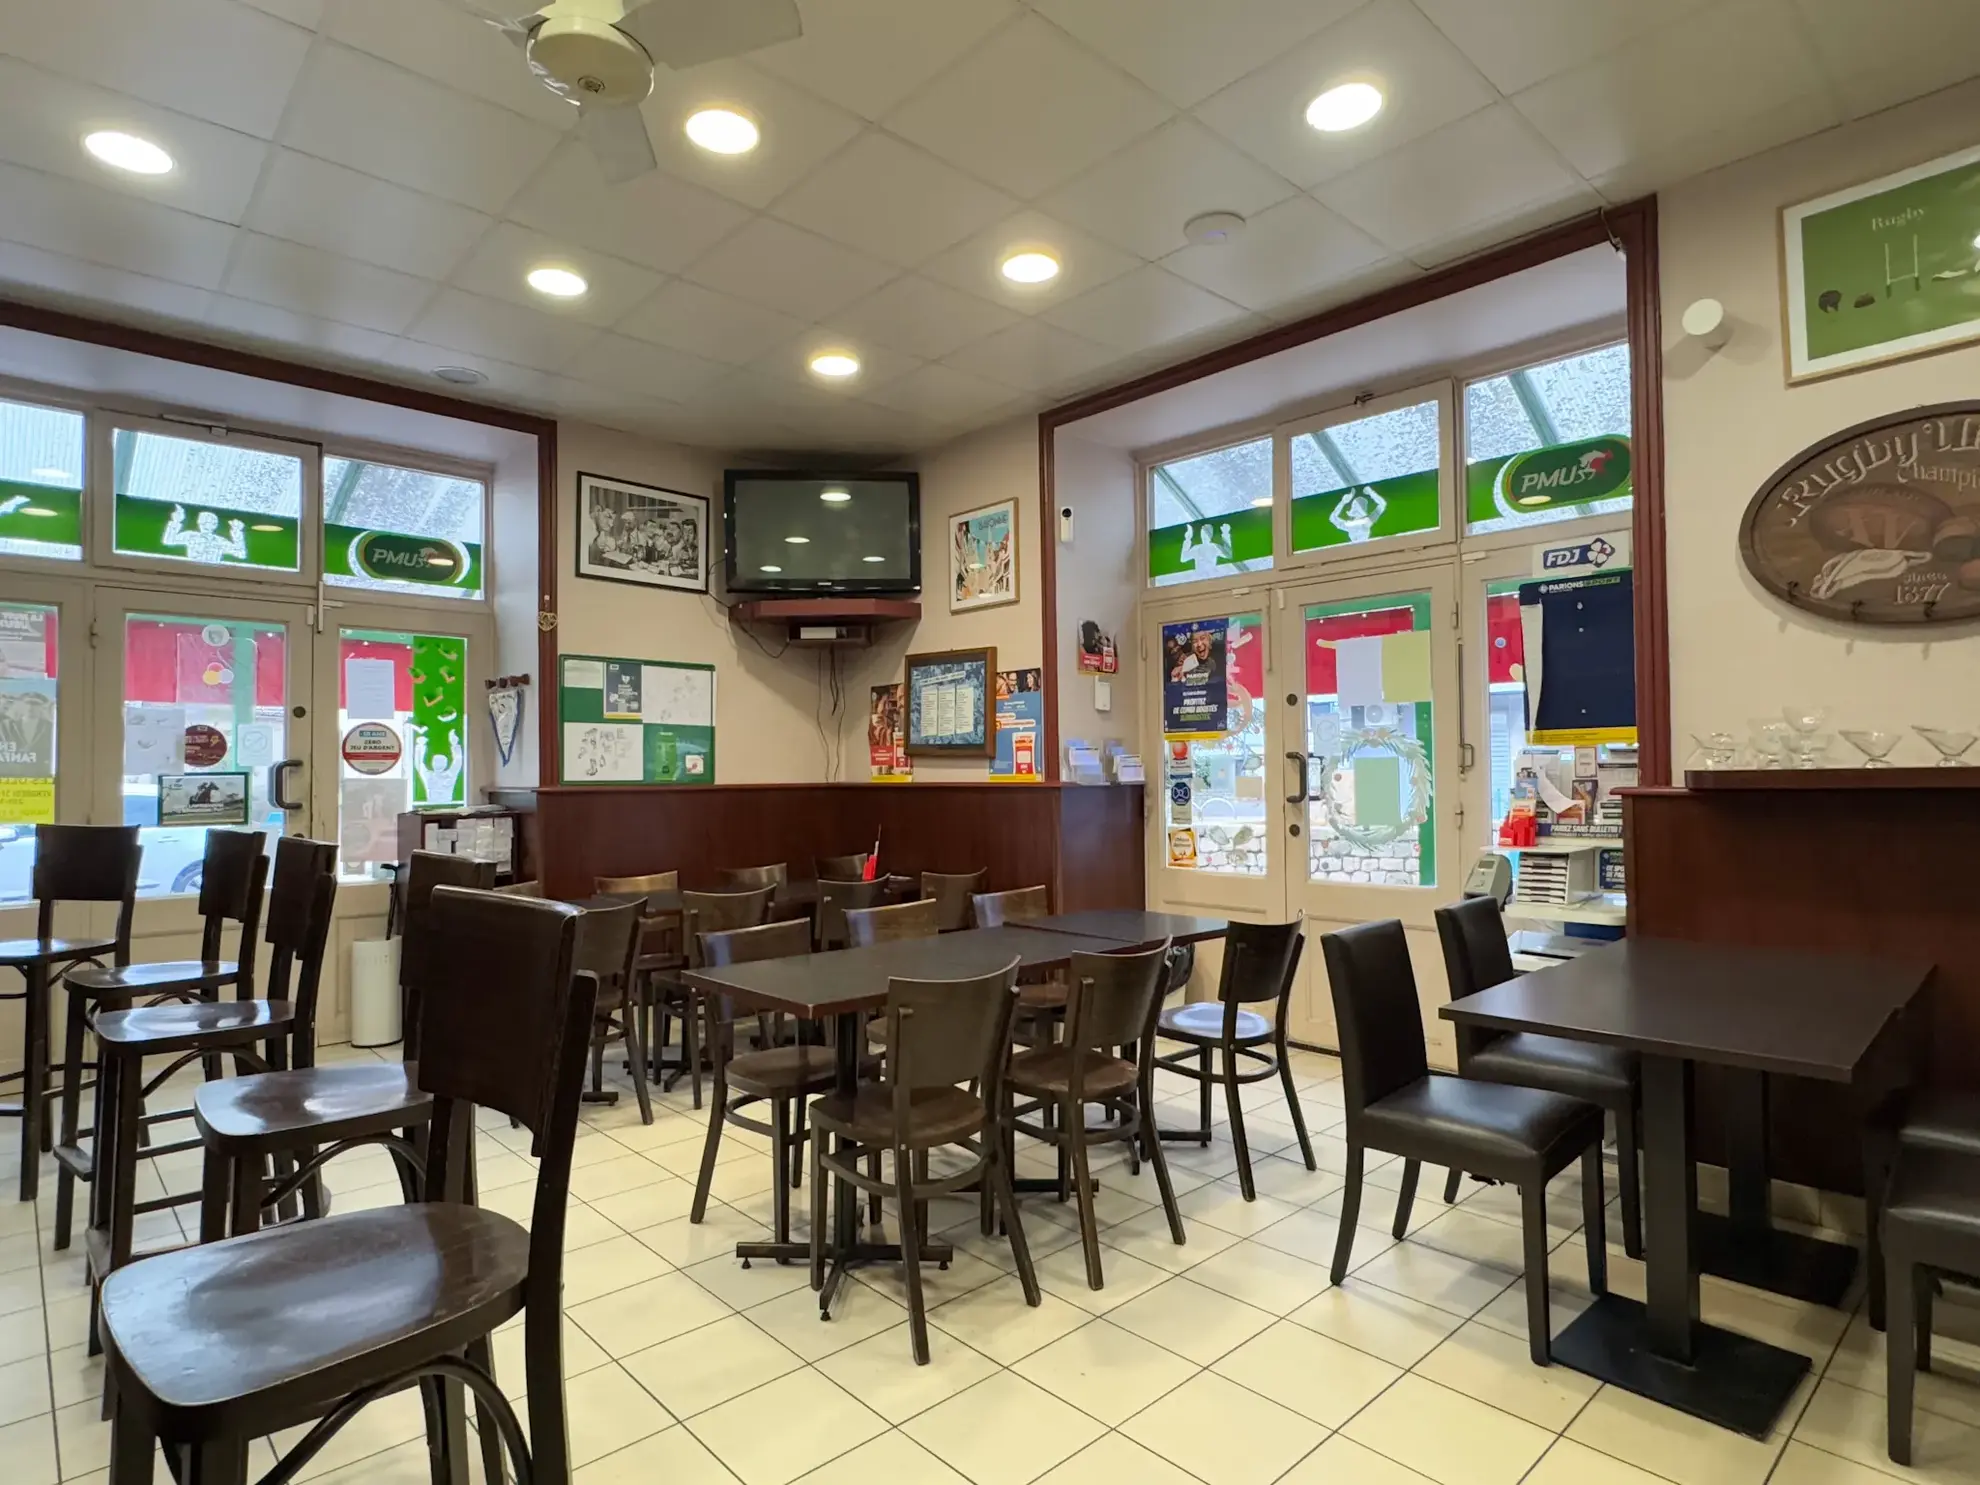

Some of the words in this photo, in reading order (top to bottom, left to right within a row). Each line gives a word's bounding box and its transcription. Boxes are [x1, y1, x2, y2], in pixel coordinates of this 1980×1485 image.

[1872, 208, 1925, 231] Rugby
[1521, 465, 1578, 493] PMU
[1776, 432, 1918, 527] Rugby
[1897, 461, 1980, 493] Champi
[372, 547, 418, 567] PMU
[1545, 549, 1581, 567] FDJ
[1549, 581, 1584, 591] PARIONS
